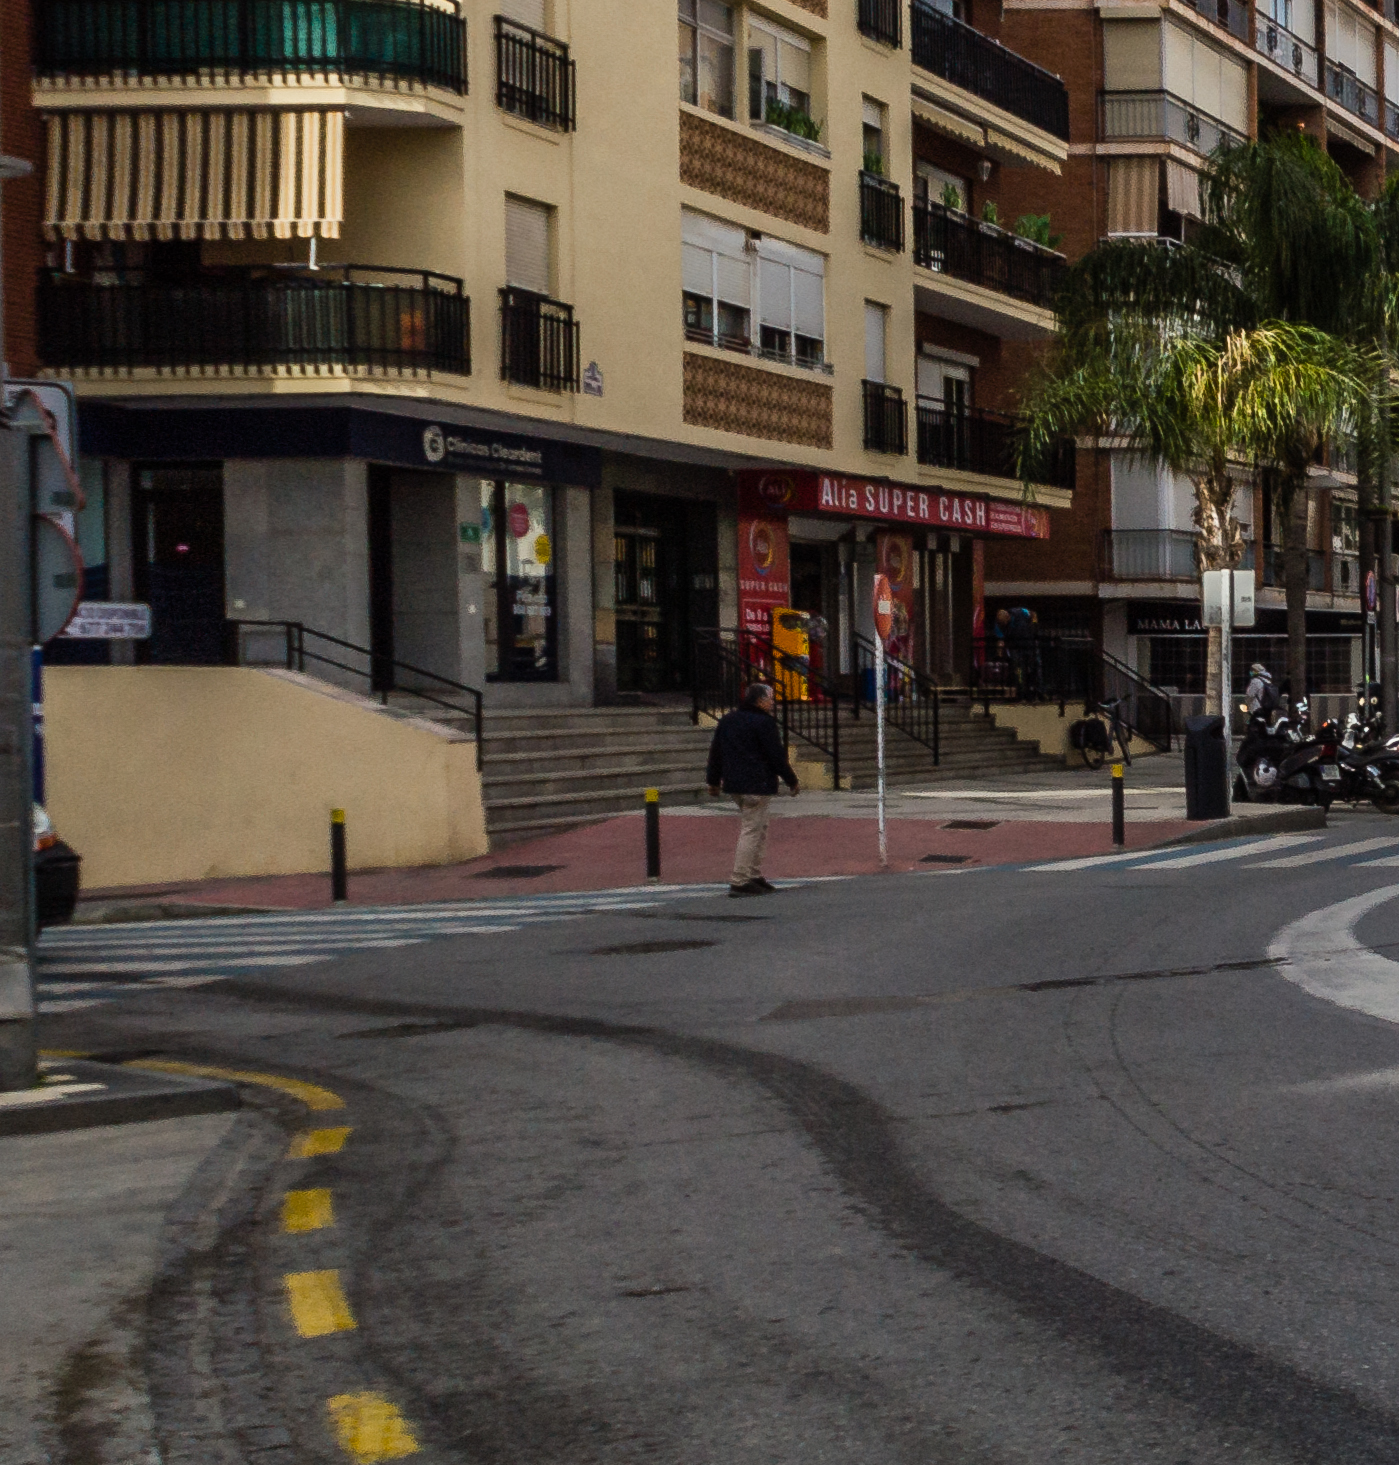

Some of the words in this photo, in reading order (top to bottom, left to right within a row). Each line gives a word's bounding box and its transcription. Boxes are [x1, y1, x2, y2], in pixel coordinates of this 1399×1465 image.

[821, 478, 858, 509] Alia
[865, 484, 929, 520] SUPER
[939, 496, 986, 526] CASH
[740, 580, 766, 592] SUPER
[768, 581, 788, 593] CASH
[1137, 619, 1180, 630] MAMA
